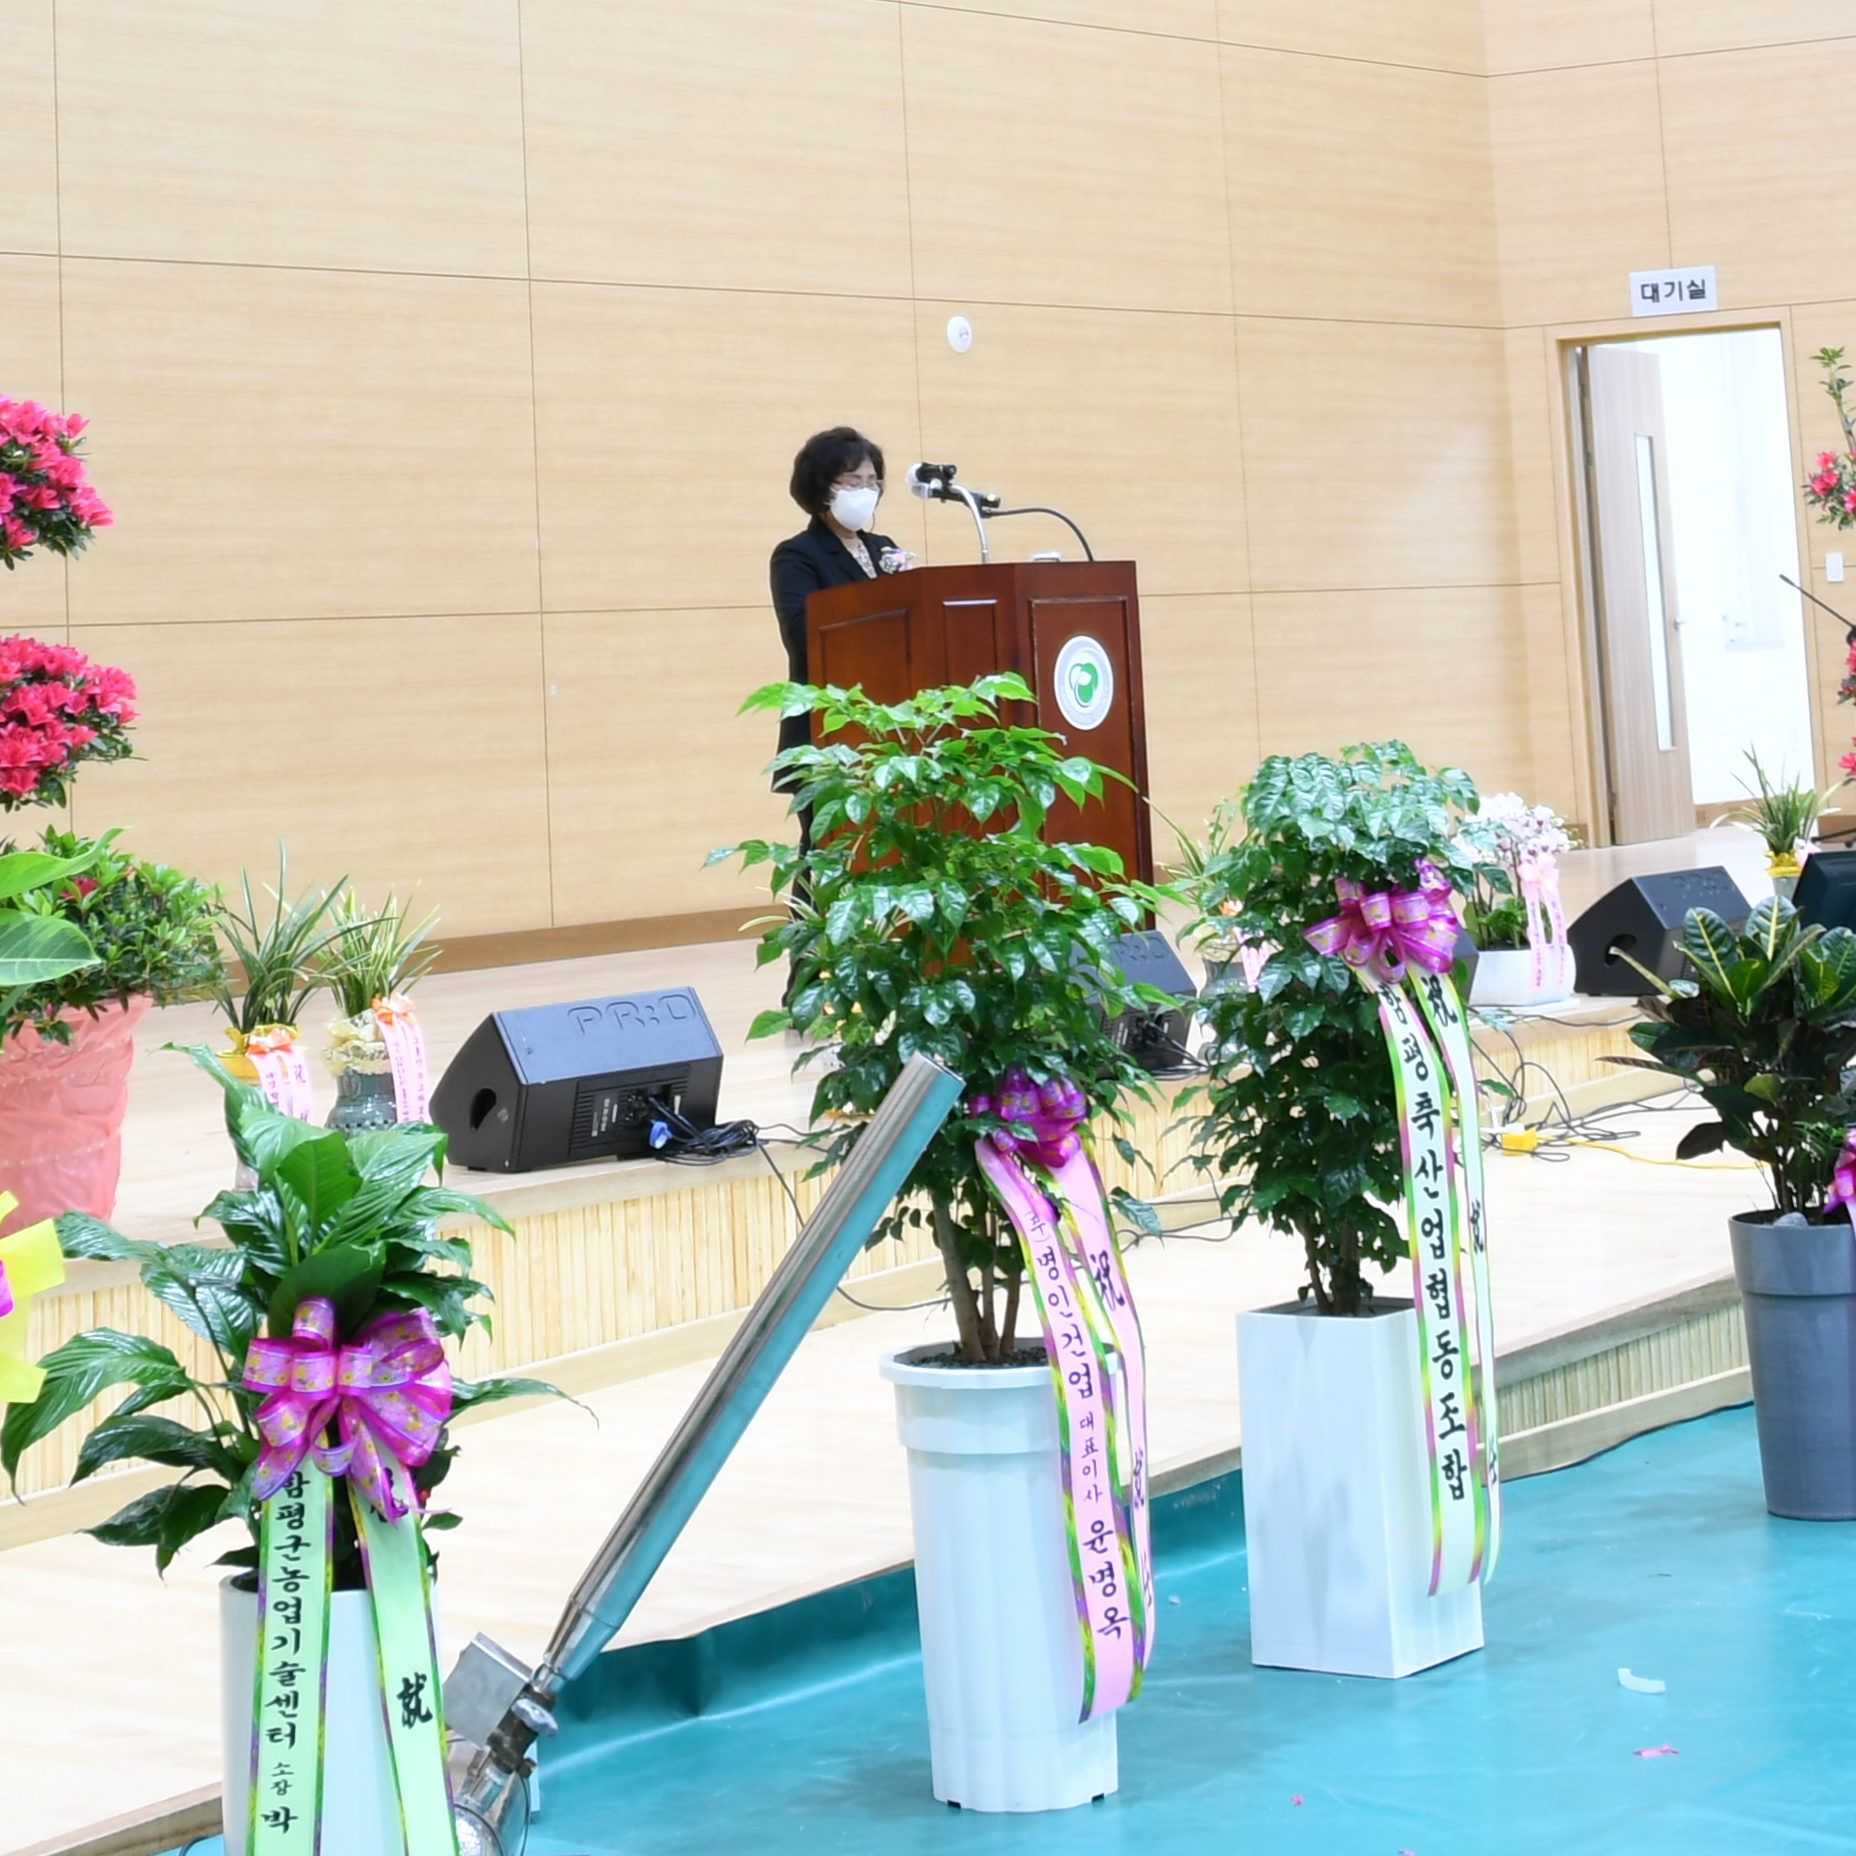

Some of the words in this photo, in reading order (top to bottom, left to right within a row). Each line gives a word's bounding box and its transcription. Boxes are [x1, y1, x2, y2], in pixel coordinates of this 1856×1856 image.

[1640, 278, 1706, 304] 대기실
[1378, 981, 1465, 1502] 함평축산업협동조합
[1090, 1249, 1126, 1312] 祝
[1079, 1411, 1103, 1504] 대표이사
[270, 1761, 295, 1797] 소장
